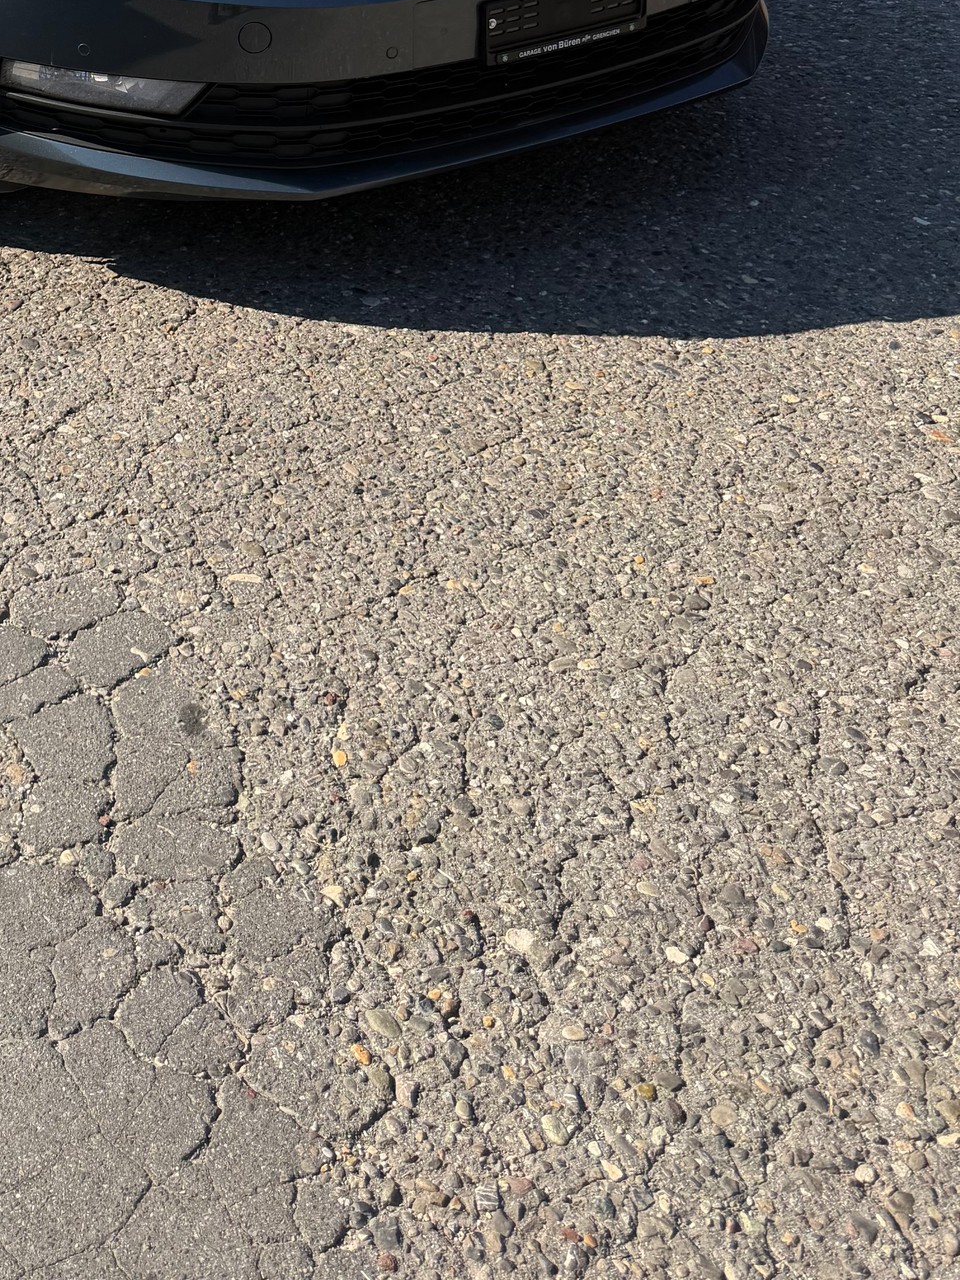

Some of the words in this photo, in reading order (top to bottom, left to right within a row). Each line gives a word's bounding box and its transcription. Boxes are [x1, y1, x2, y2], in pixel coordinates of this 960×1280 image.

[519, 47, 541, 58] GARAGE
[543, 42, 558, 53] von
[558, 37, 581, 49] Büren
[592, 28, 621, 41] GRENCHEN
